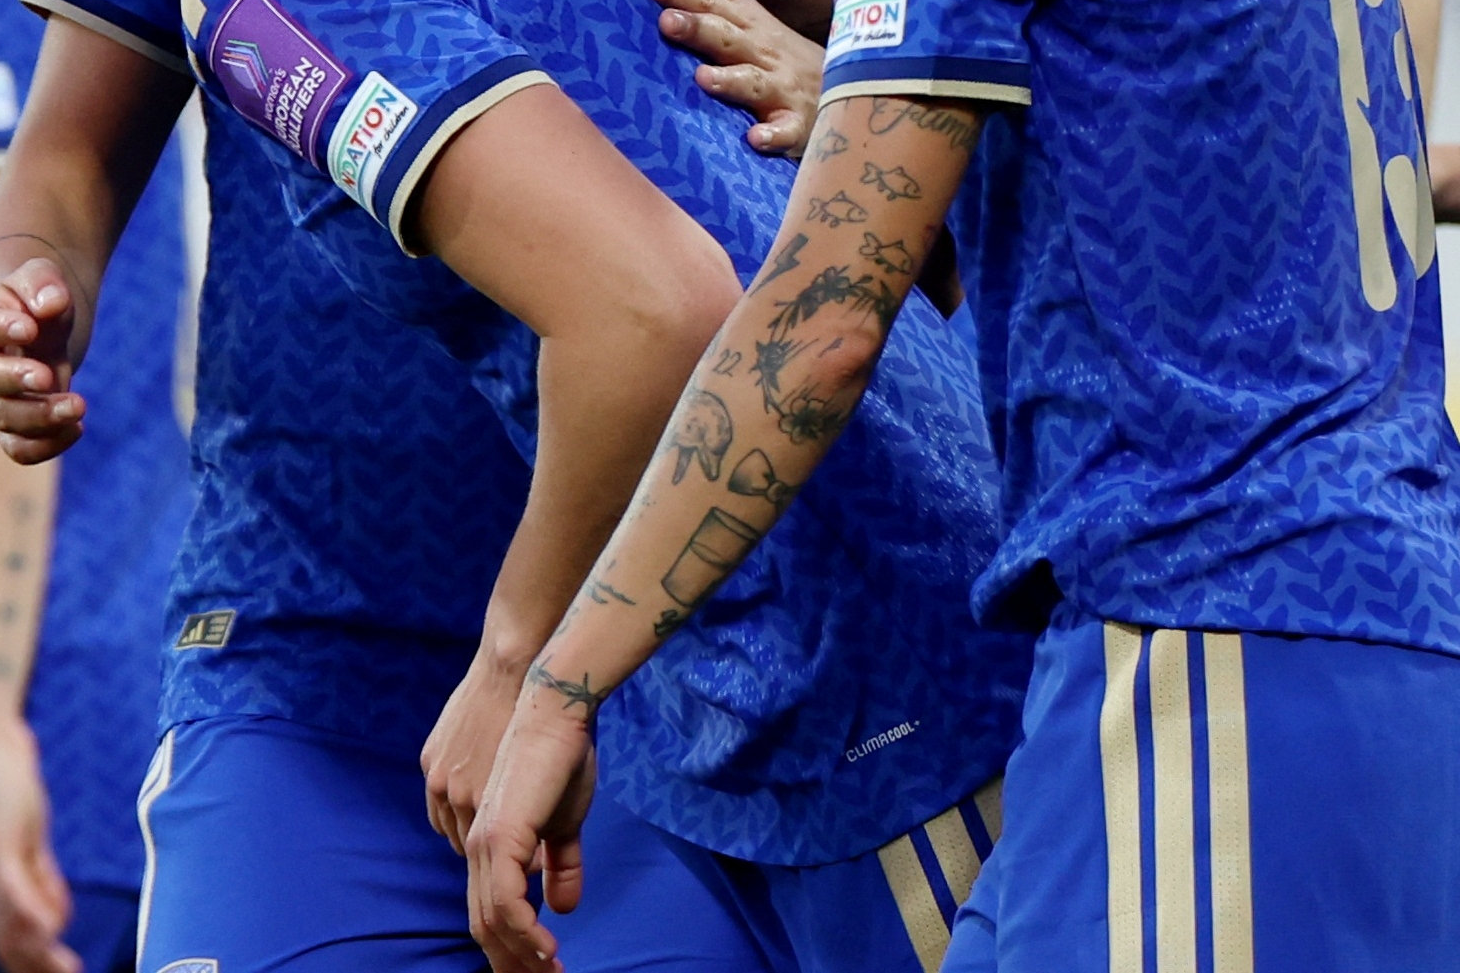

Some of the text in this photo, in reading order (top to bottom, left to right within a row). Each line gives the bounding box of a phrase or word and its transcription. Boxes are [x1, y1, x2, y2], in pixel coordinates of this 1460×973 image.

[275, 56, 314, 140] UROPEAN
[372, 106, 410, 160] for children
